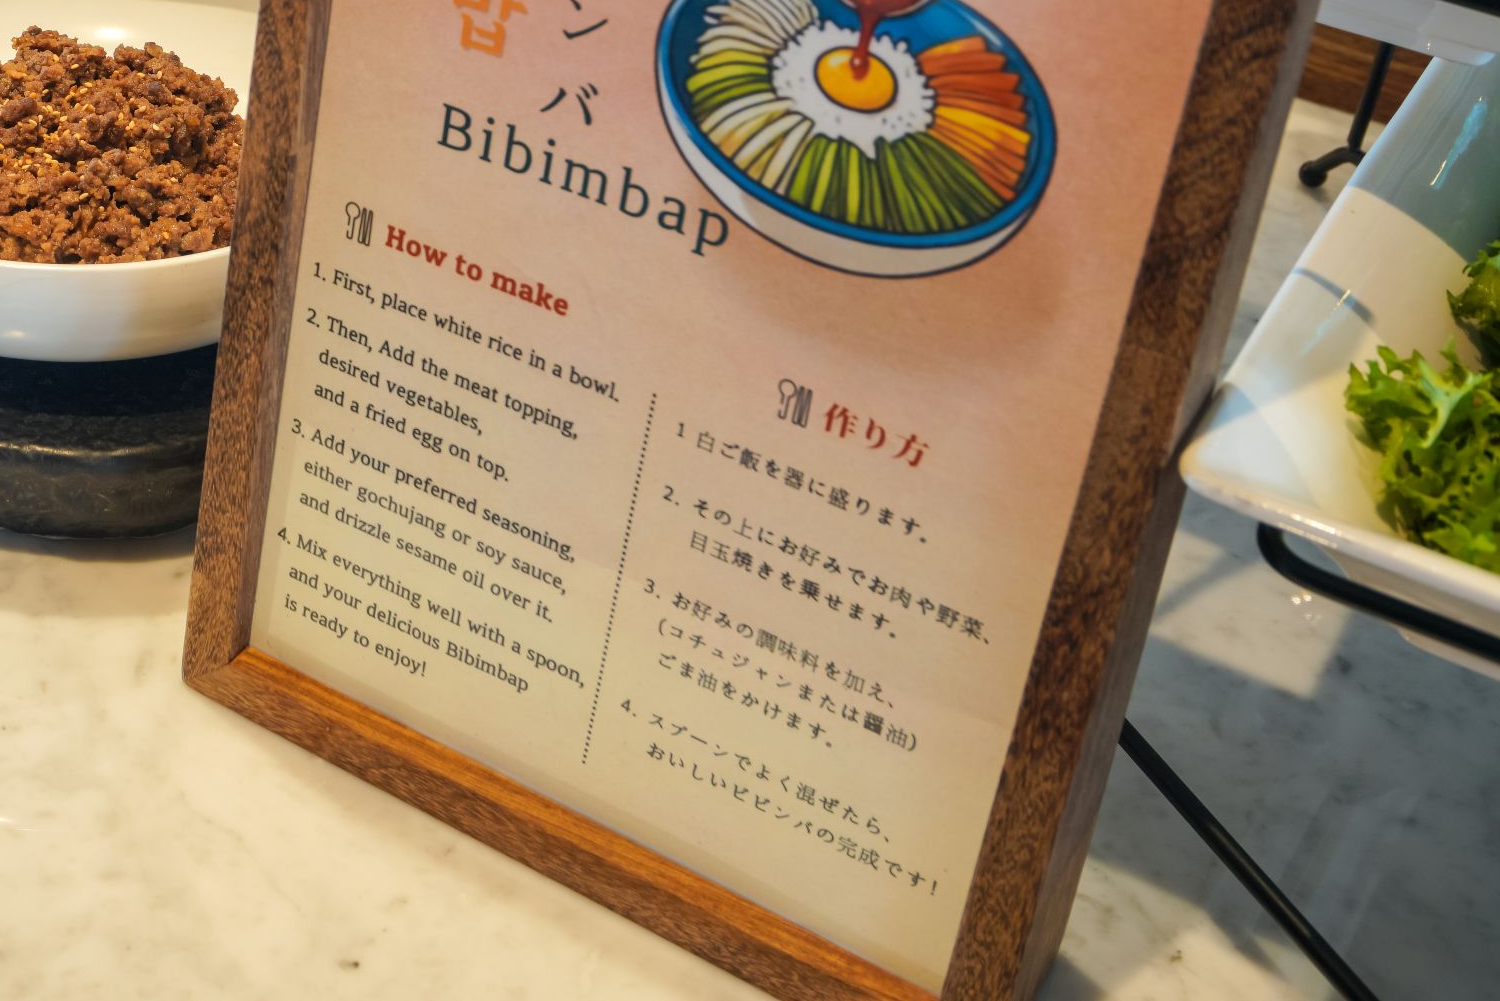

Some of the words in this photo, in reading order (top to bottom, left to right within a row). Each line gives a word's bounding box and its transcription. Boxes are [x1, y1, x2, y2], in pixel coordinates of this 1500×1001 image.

[437, 103, 729, 257] Bibimbap
[312, 262, 327, 283] 1.
[332, 269, 376, 305] First,
[381, 293, 429, 322] place
[434, 314, 483, 345] white
[487, 336, 524, 362] rice
[528, 349, 547, 372] in
[552, 364, 563, 379] a
[569, 365, 620, 403] bowl.
[385, 224, 449, 268] How
[455, 254, 484, 282] to
[490, 272, 569, 317] make
[306, 308, 321, 329] 2.
[327, 315, 373, 354] Then,
[378, 340, 416, 368] Add
[421, 358, 450, 382] the
[453, 373, 500, 404] meat
[505, 393, 578, 441] topping,
[314, 384, 346, 408] and
[350, 400, 360, 415] a
[365, 403, 407, 435] fried
[412, 427, 444, 455] egg
[448, 444, 471, 464] on
[477, 454, 509, 483] top.
[319, 349, 381, 389] desired
[386, 380, 483, 437] vegetables,
[824, 403, 930, 468] 作り方
[291, 418, 306, 439] 3.
[310, 429, 346, 457] Add
[350, 448, 391, 475] your
[394, 468, 478, 516] preferred
[482, 508, 576, 564] seasoning,
[304, 461, 354, 492] either
[357, 486, 447, 540] gochujang
[452, 529, 472, 546] or
[476, 541, 507, 566] soy
[511, 557, 567, 596] sauce,
[697, 432, 927, 544] 白ご飯を器に盛ります。
[277, 527, 291, 545] 4.
[296, 534, 328, 561] Mix
[333, 555, 423, 610] everything
[427, 599, 462, 628] well
[468, 619, 506, 648] with
[511, 641, 522, 656] a
[526, 649, 585, 690] spoon,
[300, 493, 330, 517] and
[335, 507, 391, 545] drizzle
[396, 538, 458, 576] sesame
[462, 570, 486, 591] oil
[490, 583, 532, 611] over
[536, 600, 553, 624] it.
[663, 485, 680, 507] 2.
[693, 499, 990, 645] その上にお好みでお肉や野菜、
[690, 531, 897, 639] 目玉焼きを乗せます。
[285, 594, 298, 613] is
[302, 606, 349, 640] ready
[354, 630, 370, 648] to
[375, 643, 428, 678] enjoy!
[289, 567, 320, 591] and
[323, 583, 363, 611] your
[366, 603, 441, 651] delicious
[445, 640, 529, 694] Bibimbap
[644, 578, 661, 600] 3.
[672, 592, 894, 709] お好みの調味料を加え、
[659, 653, 832, 749] ごま油をかけます。
[620, 699, 637, 718] 4.
[649, 714, 891, 844] スプーンでよく混ぜたら、
